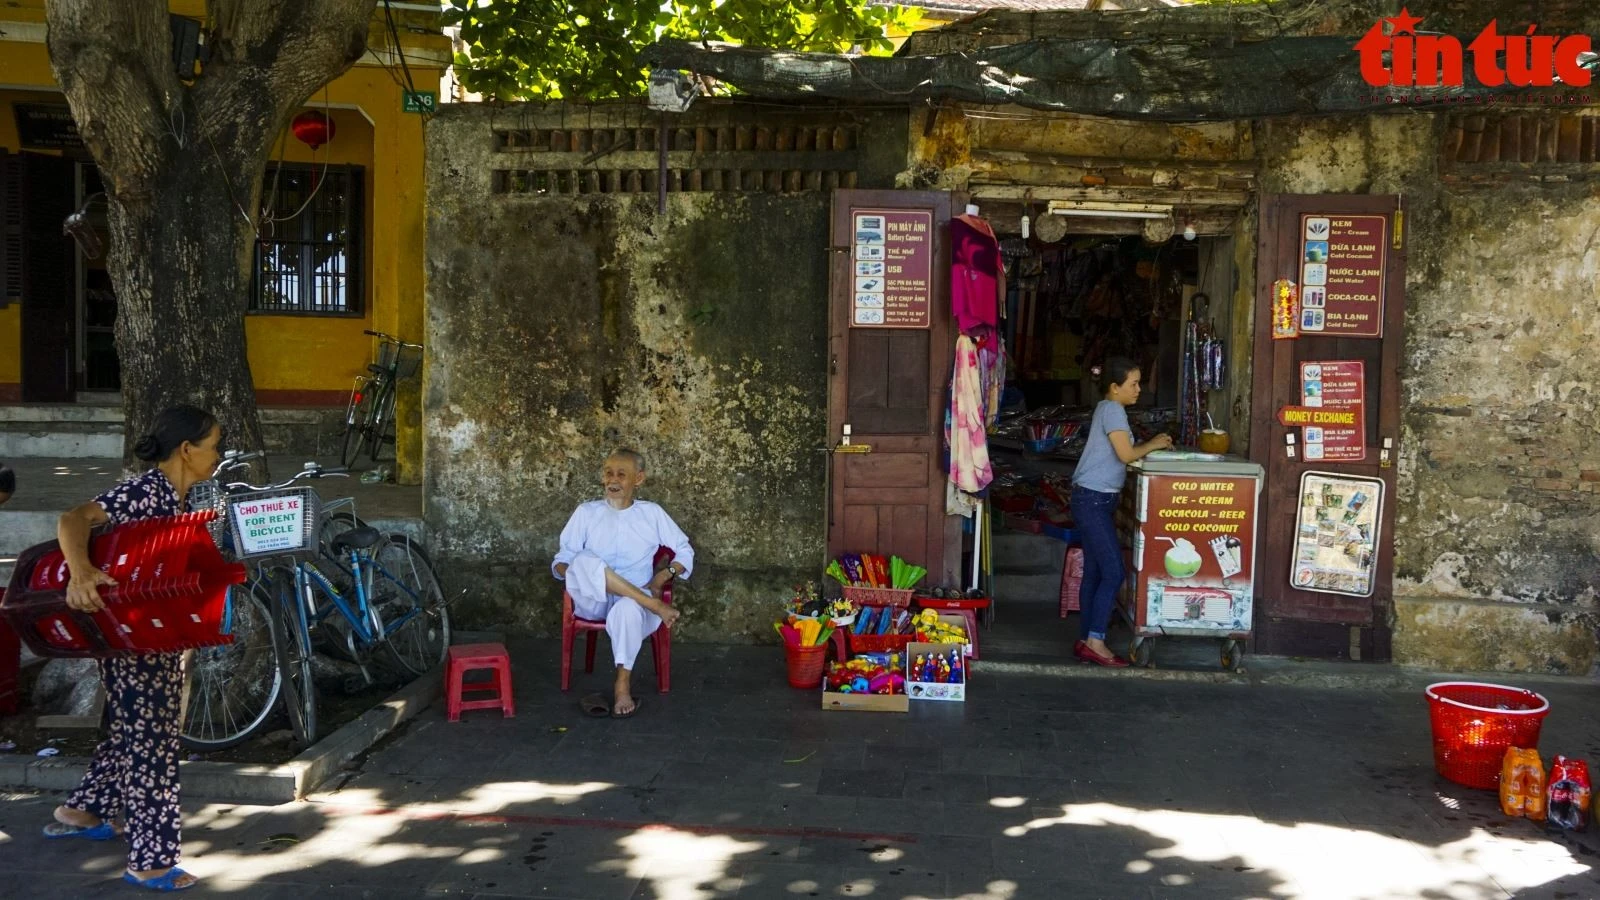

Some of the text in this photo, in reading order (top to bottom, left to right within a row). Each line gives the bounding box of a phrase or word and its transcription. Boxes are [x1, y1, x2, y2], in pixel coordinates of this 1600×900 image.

[887, 222, 898, 232] PIN
[887, 234, 904, 242] Battery
[887, 265, 902, 273] USB
[1327, 294, 1377, 302] COCA-COLA
[1284, 411, 1355, 424] MONEY EXCHANGE
[1172, 482, 1235, 492] COLD WATER
[1172, 496, 1189, 504] ICE
[1198, 496, 1234, 505] CREAM
[240, 500, 299, 516] CHO THUÊ XE
[1158, 509, 1209, 518] COCACOLA
[1218, 510, 1246, 520] BEER
[245, 513, 297, 527] FOR RENT
[250, 524, 294, 538] BICYCLE
[1165, 523, 1239, 533] COLD COCONUT
